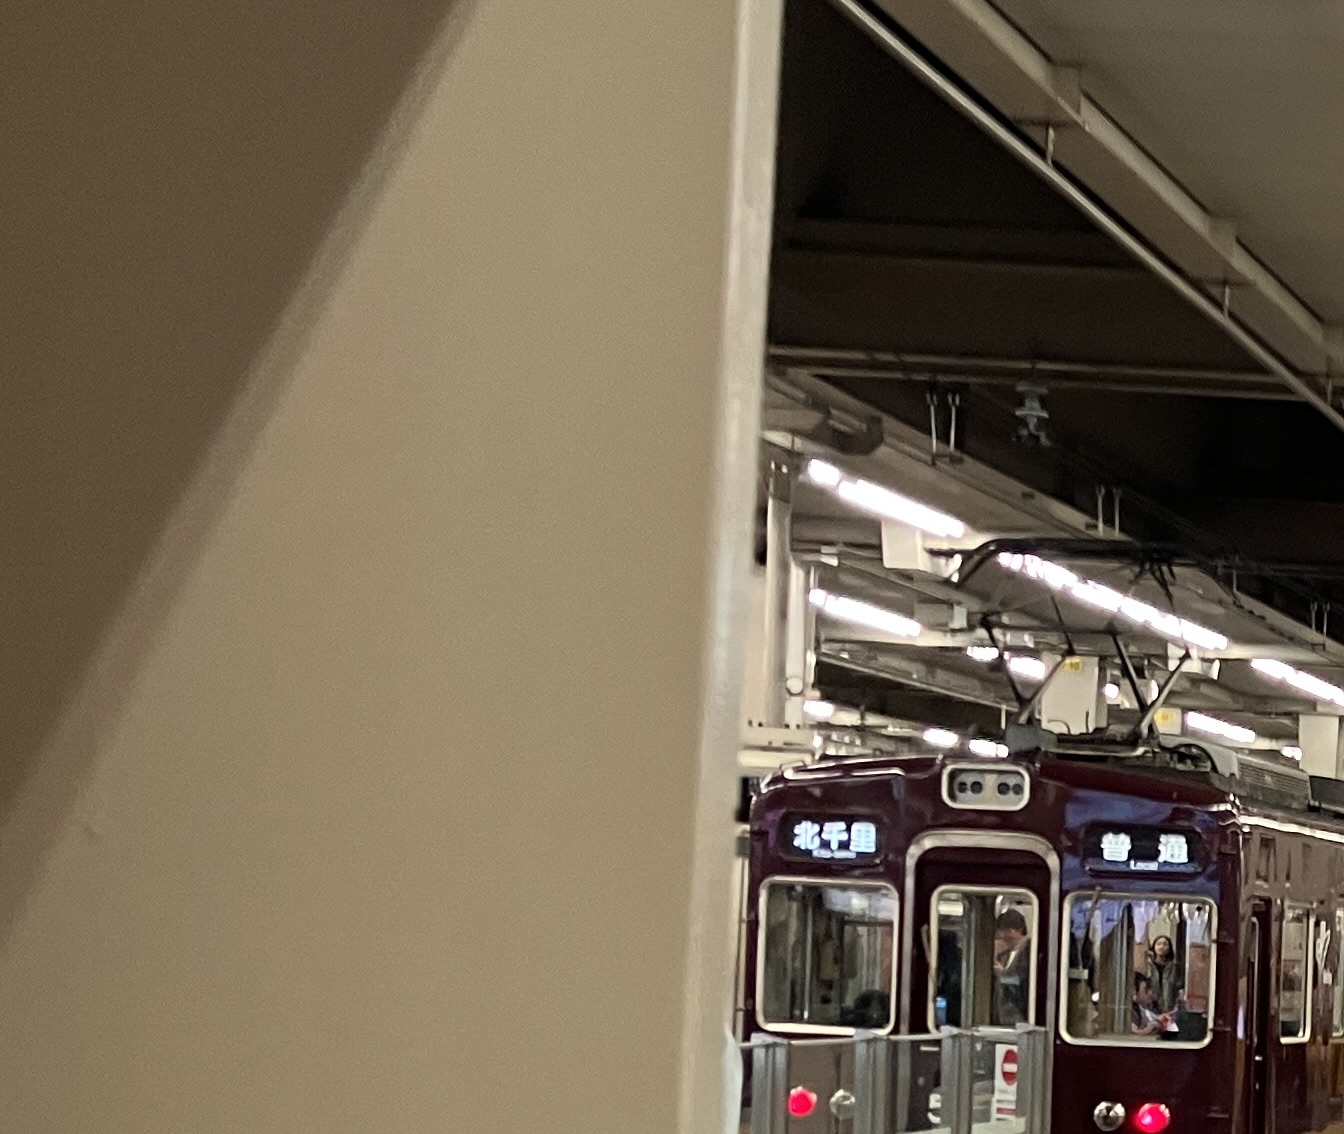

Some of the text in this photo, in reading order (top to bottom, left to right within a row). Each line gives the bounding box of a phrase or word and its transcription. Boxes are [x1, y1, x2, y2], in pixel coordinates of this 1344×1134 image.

[793, 820, 877, 853] 北千里
[1101, 832, 1188, 864] 普通
